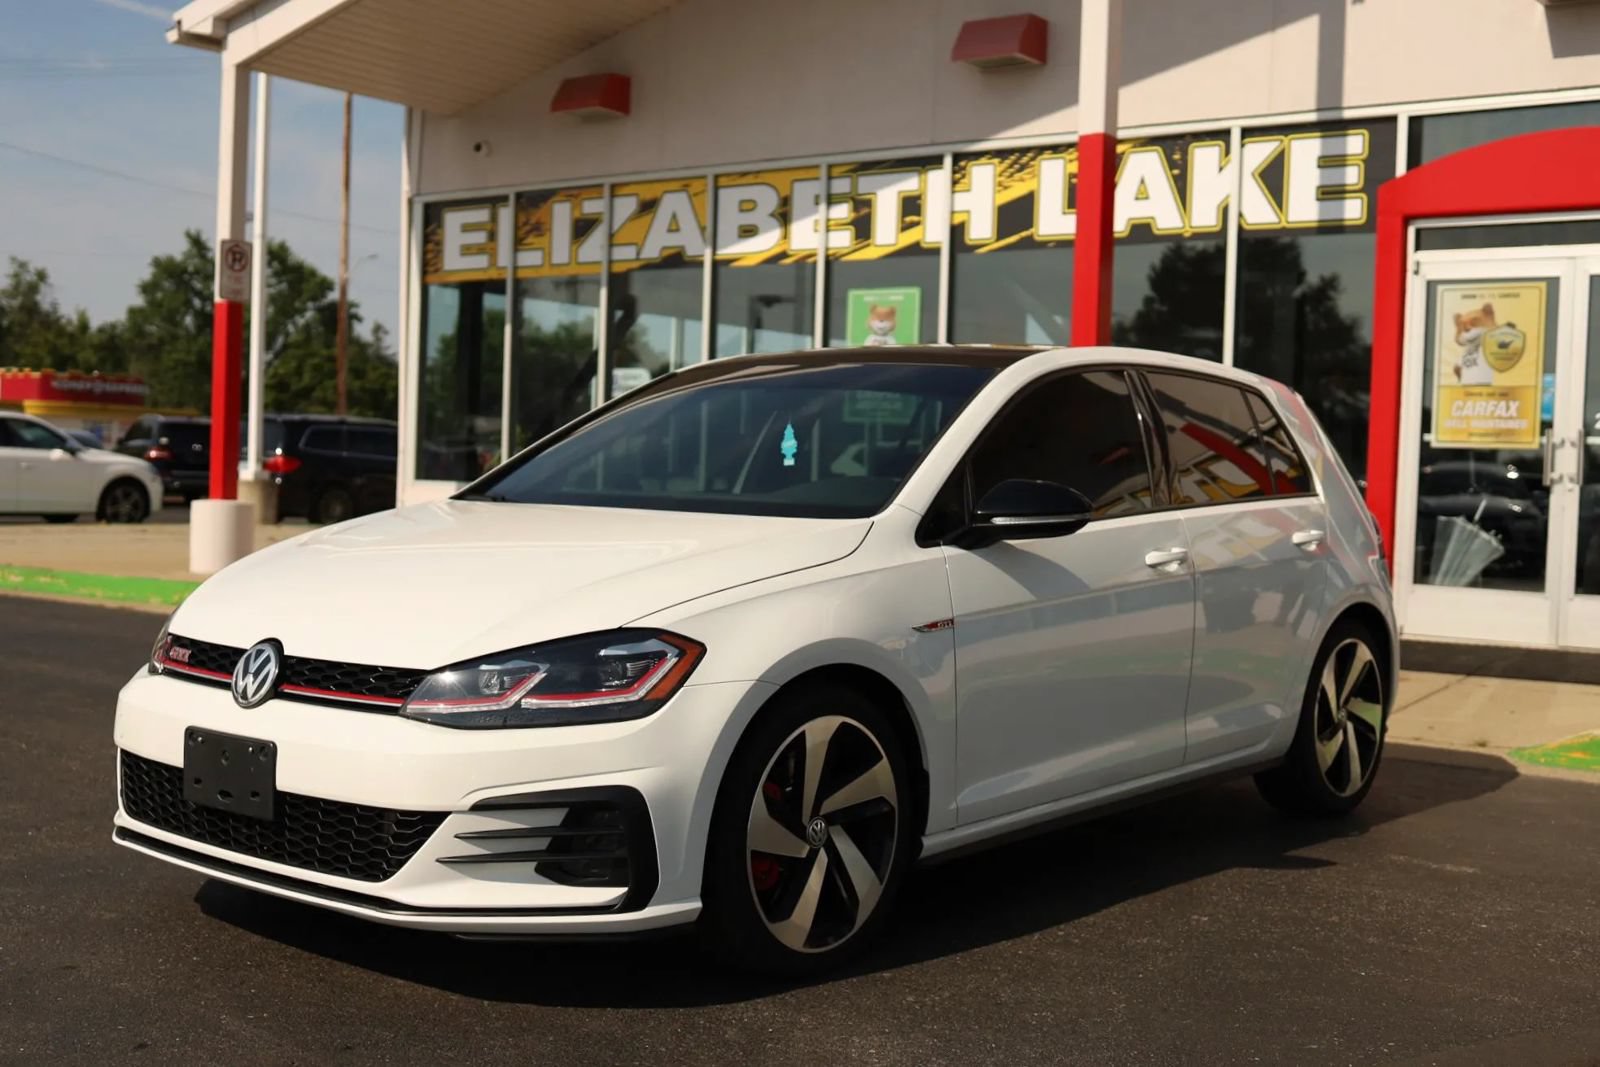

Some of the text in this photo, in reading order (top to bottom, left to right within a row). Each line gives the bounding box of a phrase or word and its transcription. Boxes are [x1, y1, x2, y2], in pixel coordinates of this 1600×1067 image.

[442, 129, 1369, 272] ELIZABETH LAKE
[1451, 399, 1520, 417] CARFAX
